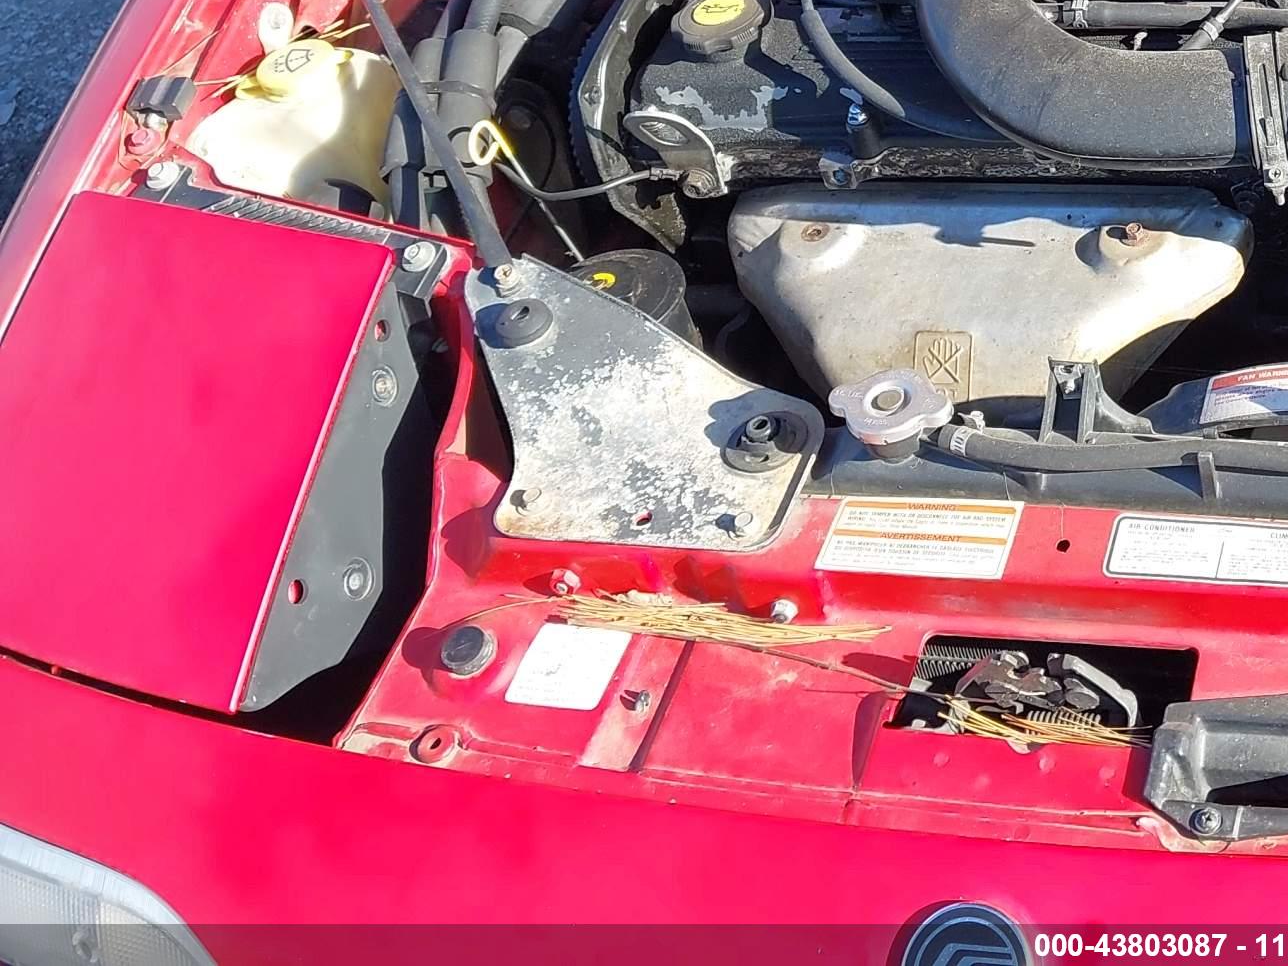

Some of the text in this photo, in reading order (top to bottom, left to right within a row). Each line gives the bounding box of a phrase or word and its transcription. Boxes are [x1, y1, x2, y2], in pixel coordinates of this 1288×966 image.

[1238, 374, 1256, 382] FAN
[907, 503, 957, 511] WARNING
[1144, 524, 1195, 533] CONDITIONER
[880, 532, 962, 542] AVERTISSEMENT
